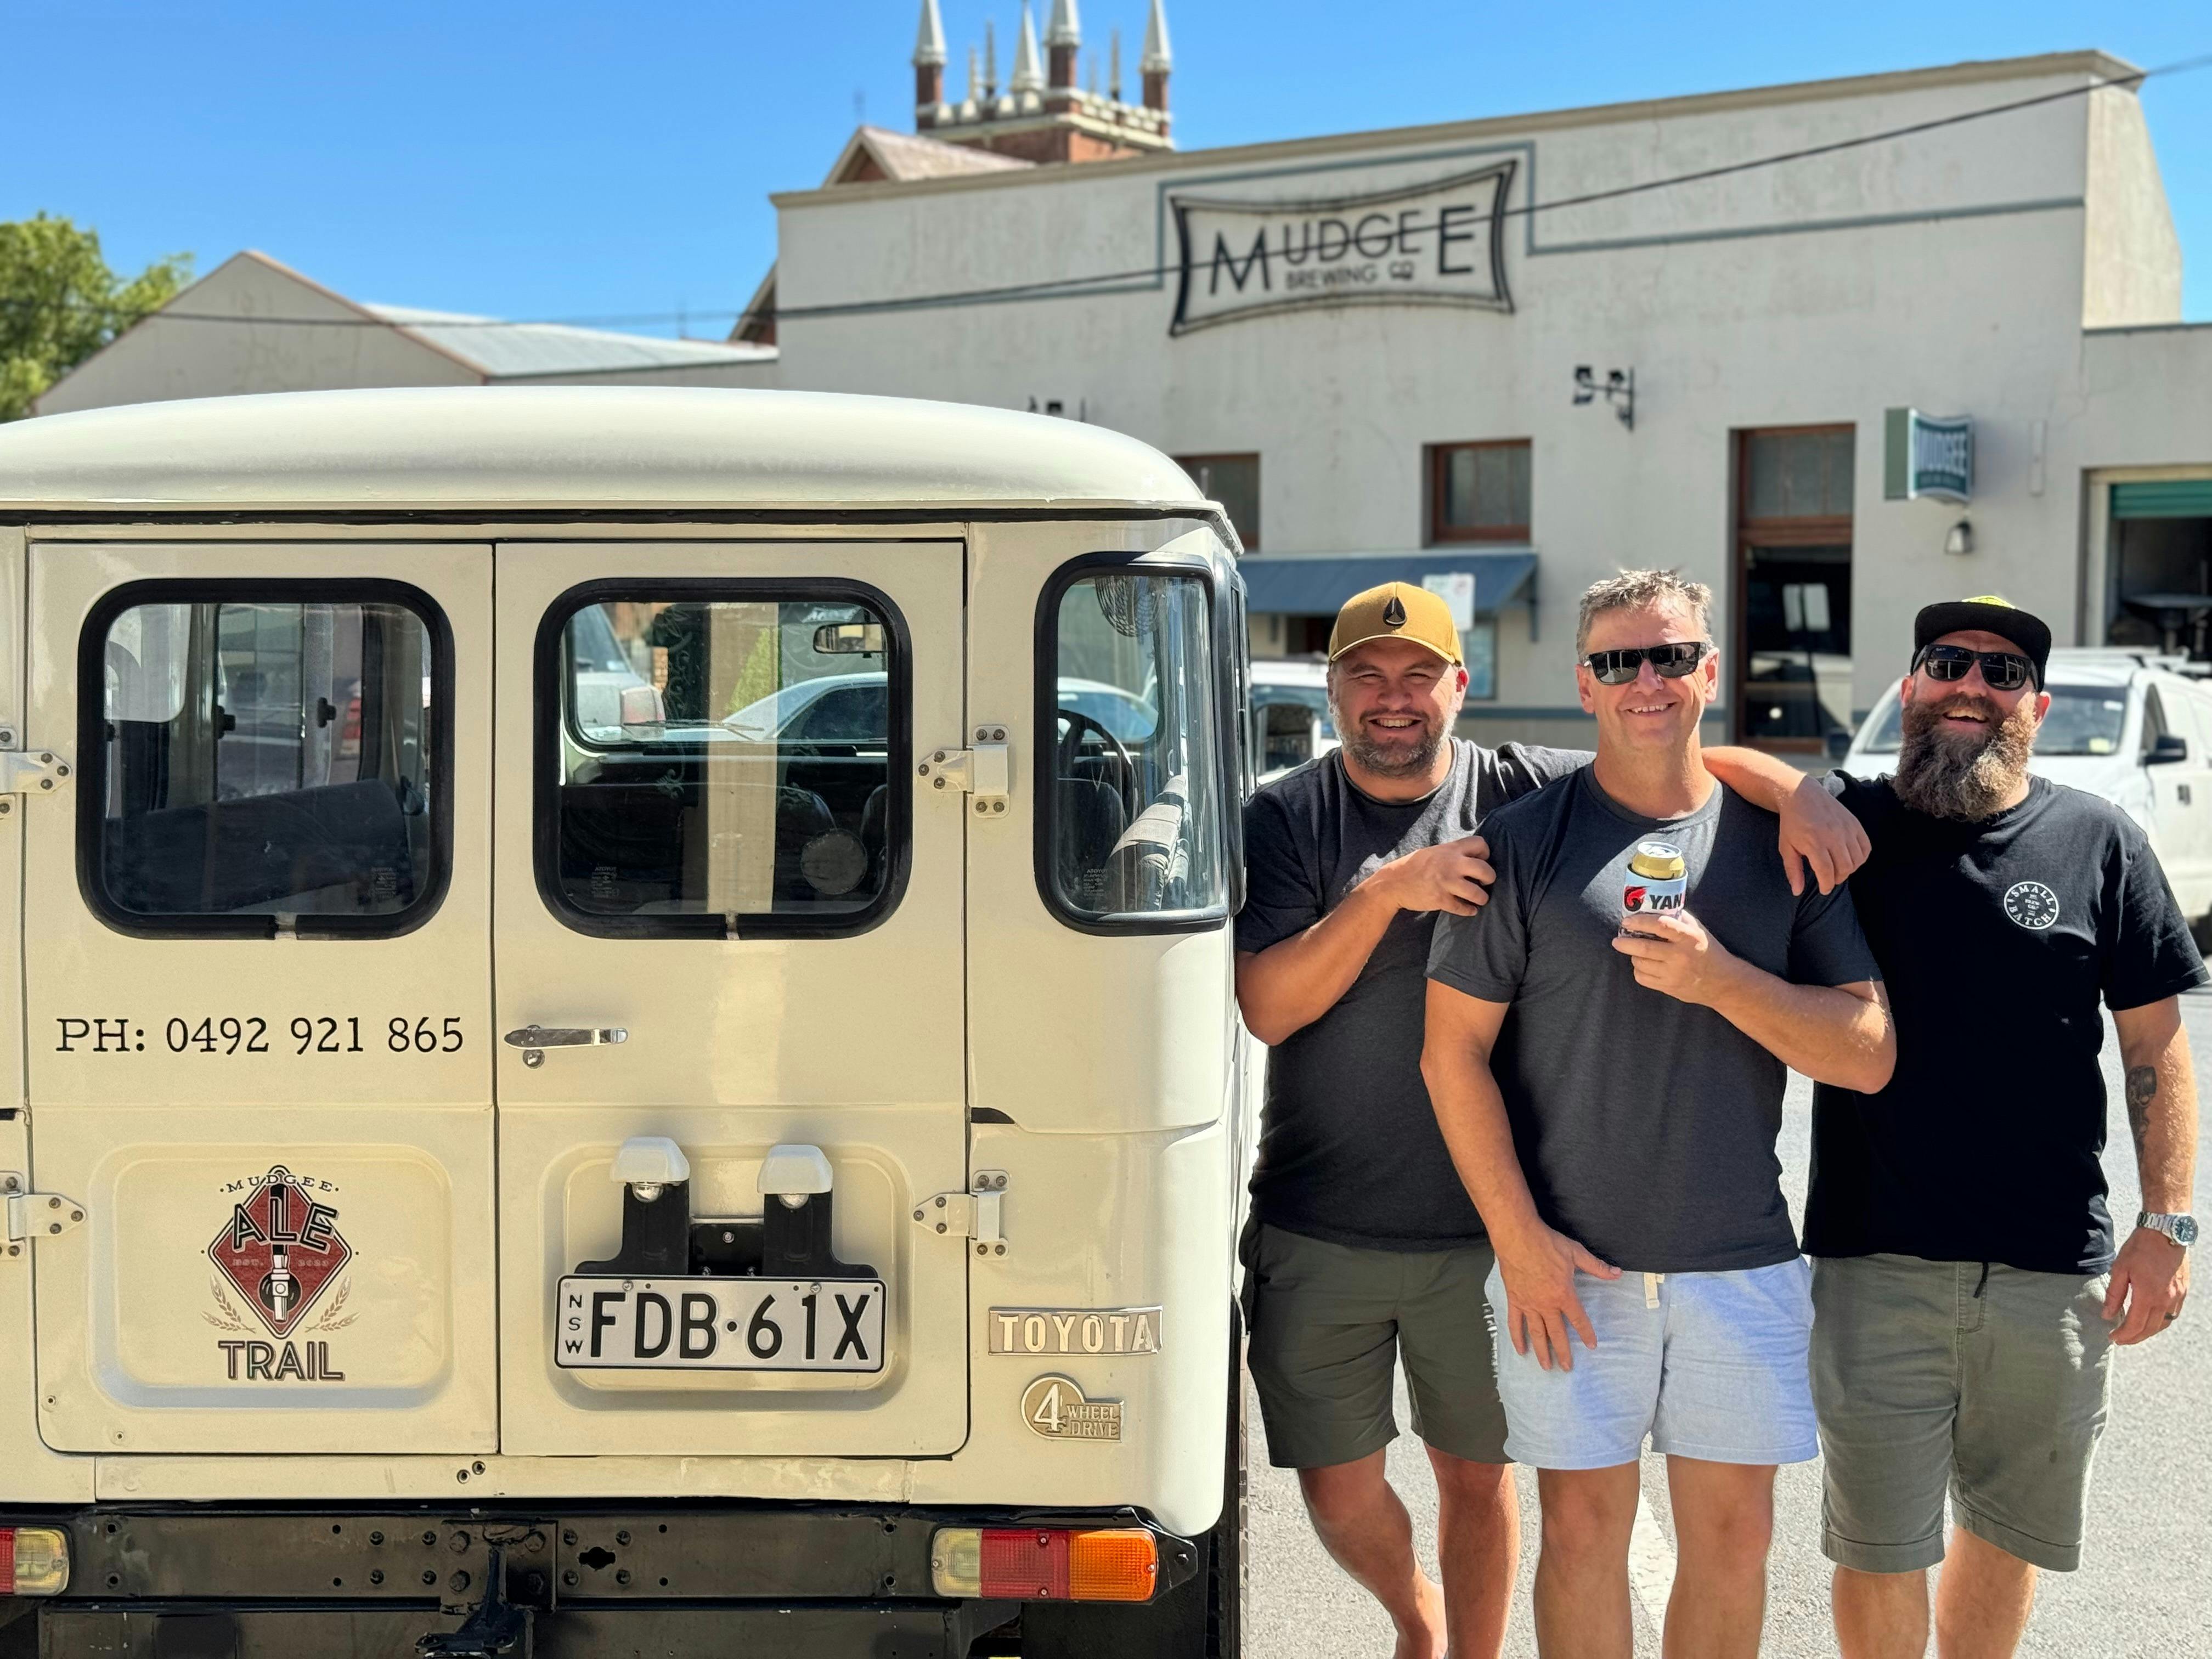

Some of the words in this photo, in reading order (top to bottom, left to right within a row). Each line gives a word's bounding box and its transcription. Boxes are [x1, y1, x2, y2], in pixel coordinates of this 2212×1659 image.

[1210, 206, 1476, 296] MUDGEE
[2011, 885, 2054, 905] SMALL
[2008, 905, 2052, 926] BATCH
[56, 1018, 145, 1053] PH:
[166, 1017, 270, 1055] 0492
[290, 1017, 364, 1056] 921
[387, 1017, 464, 1053] 865
[227, 1174, 334, 1193] MUDGEE
[232, 1196, 339, 1255] ALE
[564, 1293, 584, 1355] NSW
[997, 1313, 1155, 1353] TOYOTA
[218, 1340, 346, 1381] TRAIL
[1032, 1382, 1067, 1434] 4
[1066, 1404, 1120, 1420] WHEEL
[1070, 1420, 1119, 1437] DRIVE
